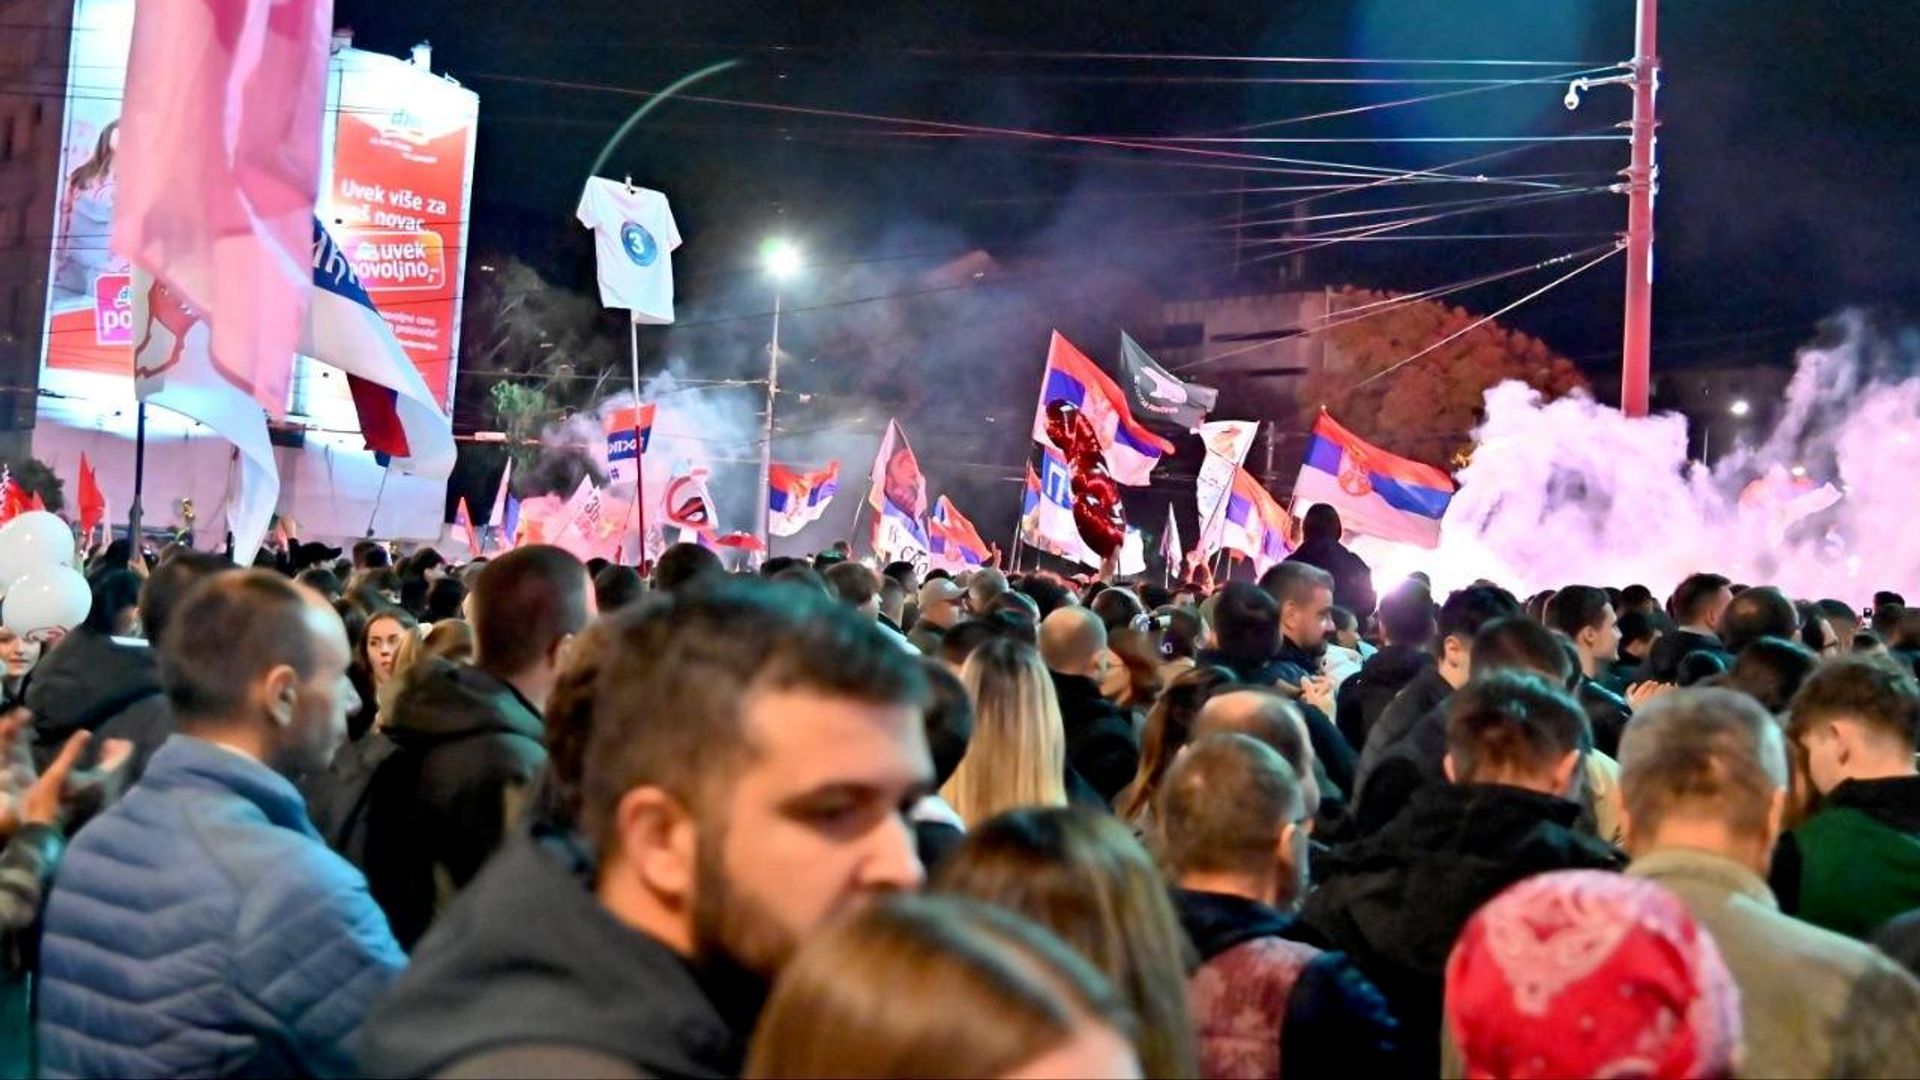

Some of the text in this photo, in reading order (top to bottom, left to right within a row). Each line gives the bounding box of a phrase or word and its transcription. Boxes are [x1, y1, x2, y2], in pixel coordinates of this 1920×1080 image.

[342, 180, 447, 215] Uvek više za
[375, 211, 426, 233] novac
[381, 242, 427, 260] uvek
[628, 231, 646, 255] 3
[104, 310, 132, 335] po
